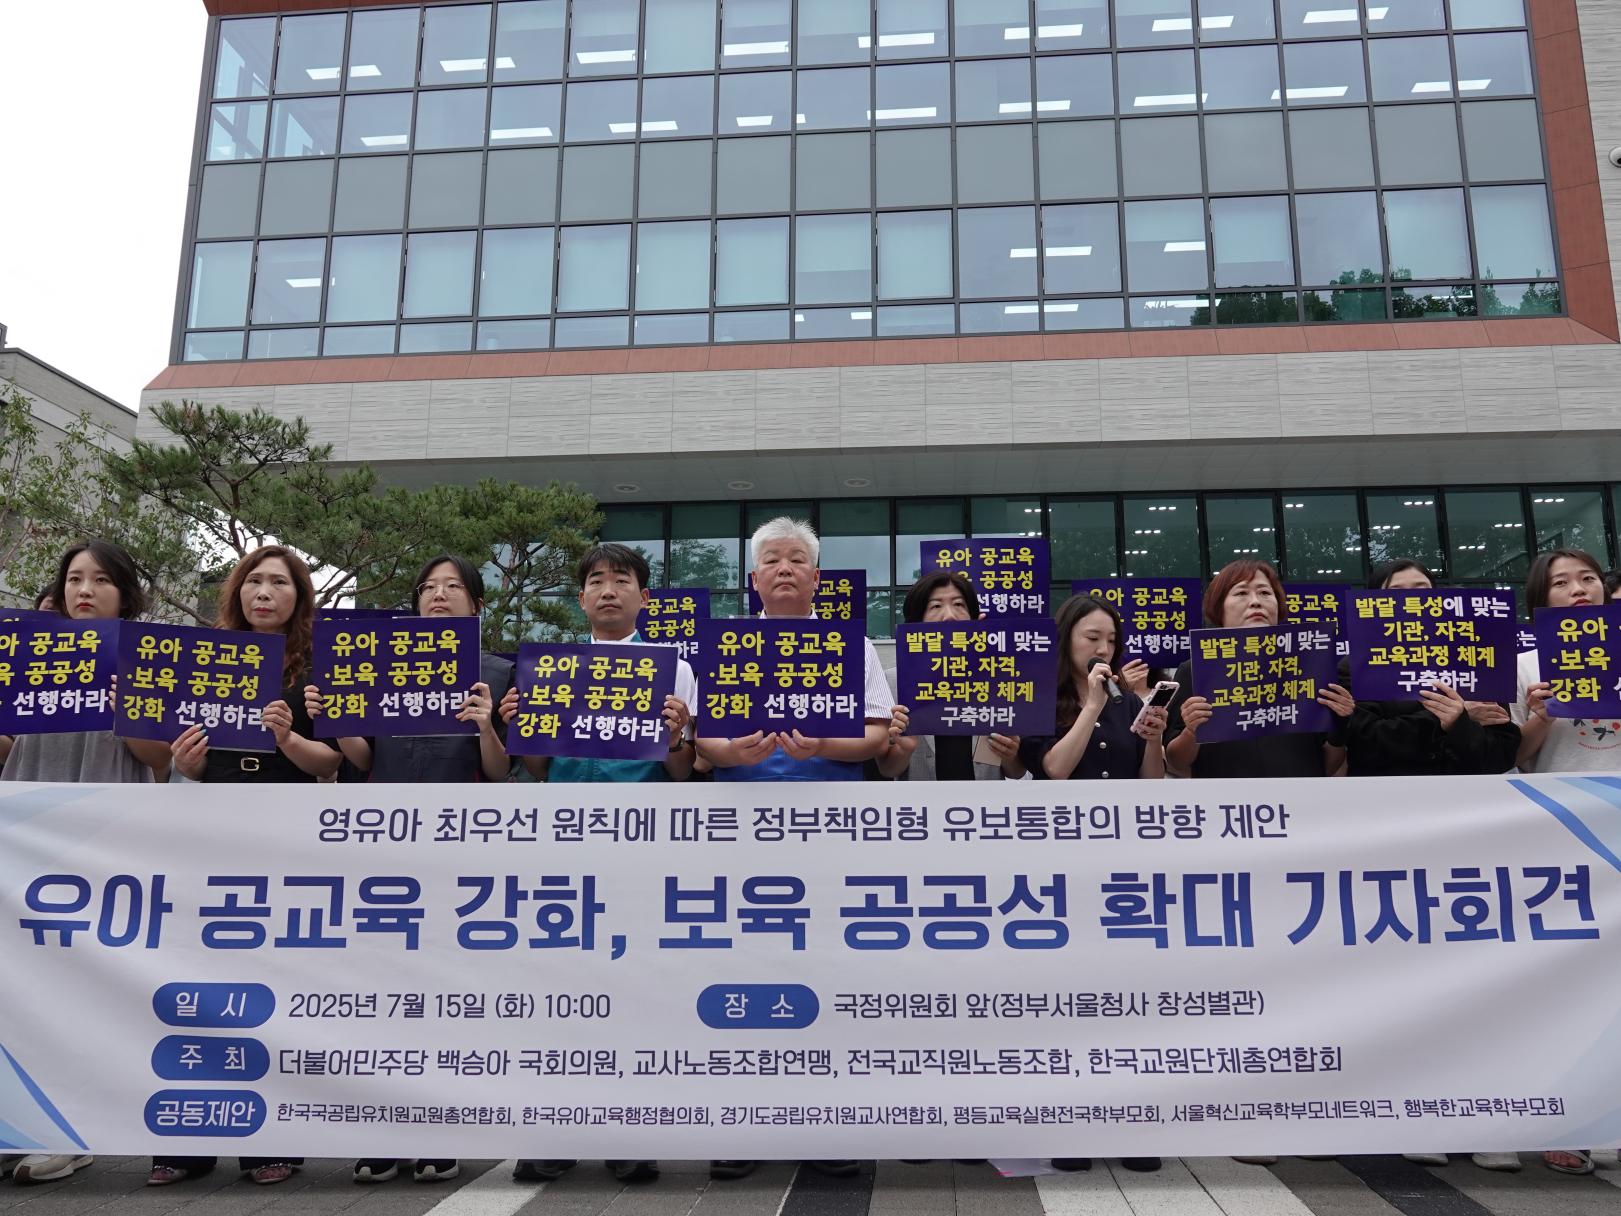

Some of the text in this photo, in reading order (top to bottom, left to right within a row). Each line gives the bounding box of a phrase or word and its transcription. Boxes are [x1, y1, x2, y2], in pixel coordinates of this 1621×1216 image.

[936, 547, 1034, 568] 유아 공교육
[813, 579, 853, 597] 교육
[980, 570, 1032, 590] 공공성
[646, 596, 696, 616] 공교육
[976, 594, 1044, 614] 선행하라
[1132, 587, 1188, 606] 공교육
[1286, 594, 1339, 613] 공교육
[1356, 596, 1510, 618] 발달 특성에 맞는
[645, 618, 695, 638] 공공성
[1132, 611, 1185, 630] 공공성
[1384, 621, 1481, 642] 기관, 자격,
[1557, 617, 1608, 642] 유아
[0, 630, 102, 656] 아 공교육
[332, 630, 460, 656] 유아 공교육
[718, 632, 765, 656] 유아
[775, 632, 846, 656] 공교육
[906, 631, 1051, 653] 발달 특성에 맞는
[1200, 637, 1238, 659] 발달
[1244, 632, 1292, 656] 특성에
[1298, 630, 1331, 651] 맞는
[1517, 630, 1536, 647] 는
[136, 636, 264, 669] 유아 공교육
[1368, 646, 1449, 666] 교육과정
[1458, 646, 1495, 667] 체계
[0, 659, 96, 686] 육 공공성
[388, 660, 457, 686] 공공성
[534, 655, 657, 682] 유아 공교육
[774, 662, 843, 687] 공공성
[931, 656, 1021, 677] 기관, 자격,
[1226, 656, 1302, 683] 기관, 자격,
[188, 672, 259, 700] 공공성
[915, 681, 1034, 702] 교육과정 체계
[1212, 679, 1315, 708] 교육과정 체계
[1398, 670, 1478, 692] 구축하라
[1550, 677, 1601, 703] 강화
[12, 688, 109, 716] 선행하라
[322, 690, 470, 719] 강화 선행하라
[584, 686, 652, 712] 공공성
[706, 694, 857, 719] 강화 선행하라
[123, 696, 267, 732] 강화 선행하라
[941, 706, 1015, 727] 구축하라
[1236, 704, 1299, 731] 구축하라
[517, 713, 664, 742] 강화 선행하라
[319, 804, 1290, 843] 영유아 최우선 원칙에 따른 정부책임형 유보통합의 방향 제안
[18, 865, 1600, 960] 유아 공교육 강화, 보육 공공성 확대 기자회견
[289, 993, 610, 1019] 2025년 7월 15일 (화) 10:00
[834, 990, 1264, 1018] 국정위원회 앞(정부서울청사 창성별관)
[280, 1046, 1344, 1079] 더불어민주당 백승아 국회의원, 교사노동조합연맹, 전국교직원노동조합, 한국교원단체총연합회
[156, 1101, 255, 1127] 공동제안
[278, 1097, 1566, 1127] 한국국공립유치원교원총연합회, 한국유아교육행정협의회, 경기도공립유치원교사연합회, 평등교육실현전국학부모회, 서울혁신교육학부모네트워크, 행복한교육학부모회
